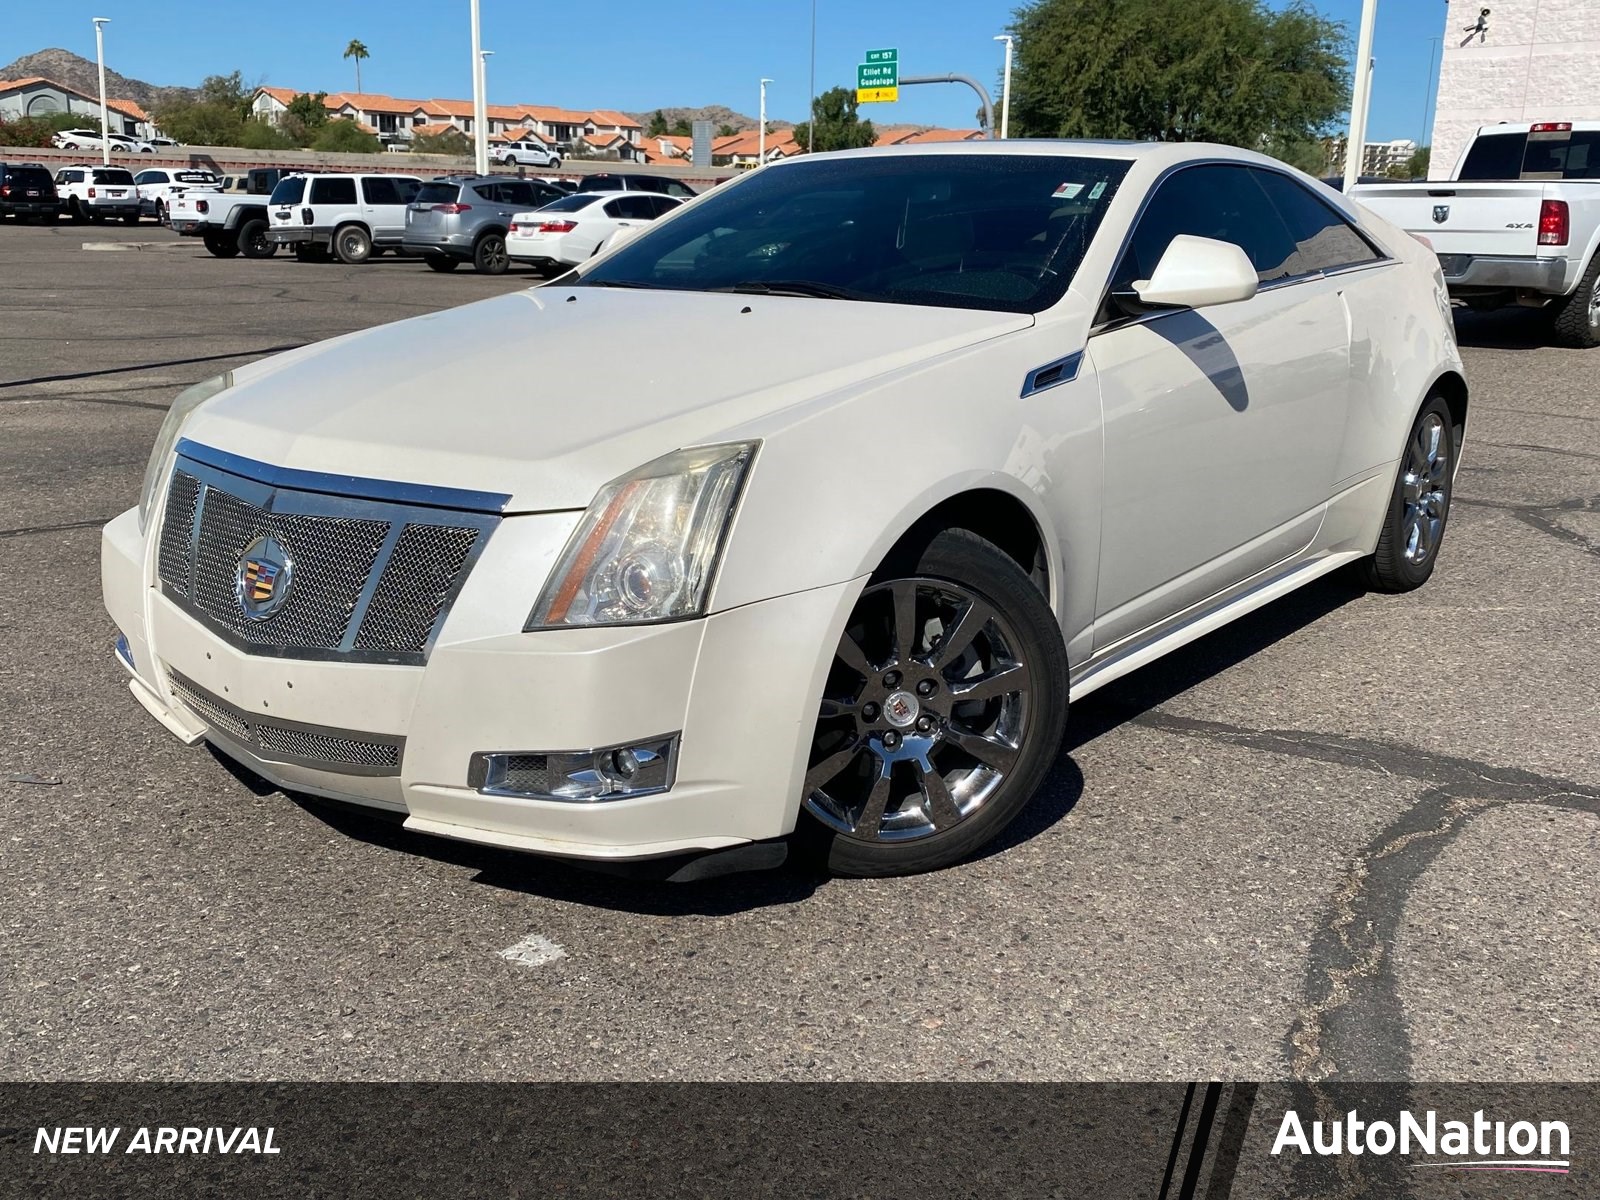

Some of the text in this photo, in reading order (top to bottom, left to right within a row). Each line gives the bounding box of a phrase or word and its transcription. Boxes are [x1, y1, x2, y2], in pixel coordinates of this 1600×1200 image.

[882, 51, 892, 59] 157
[863, 66, 892, 76] Elliot Rd
[860, 78, 894, 86] Guadalupe
